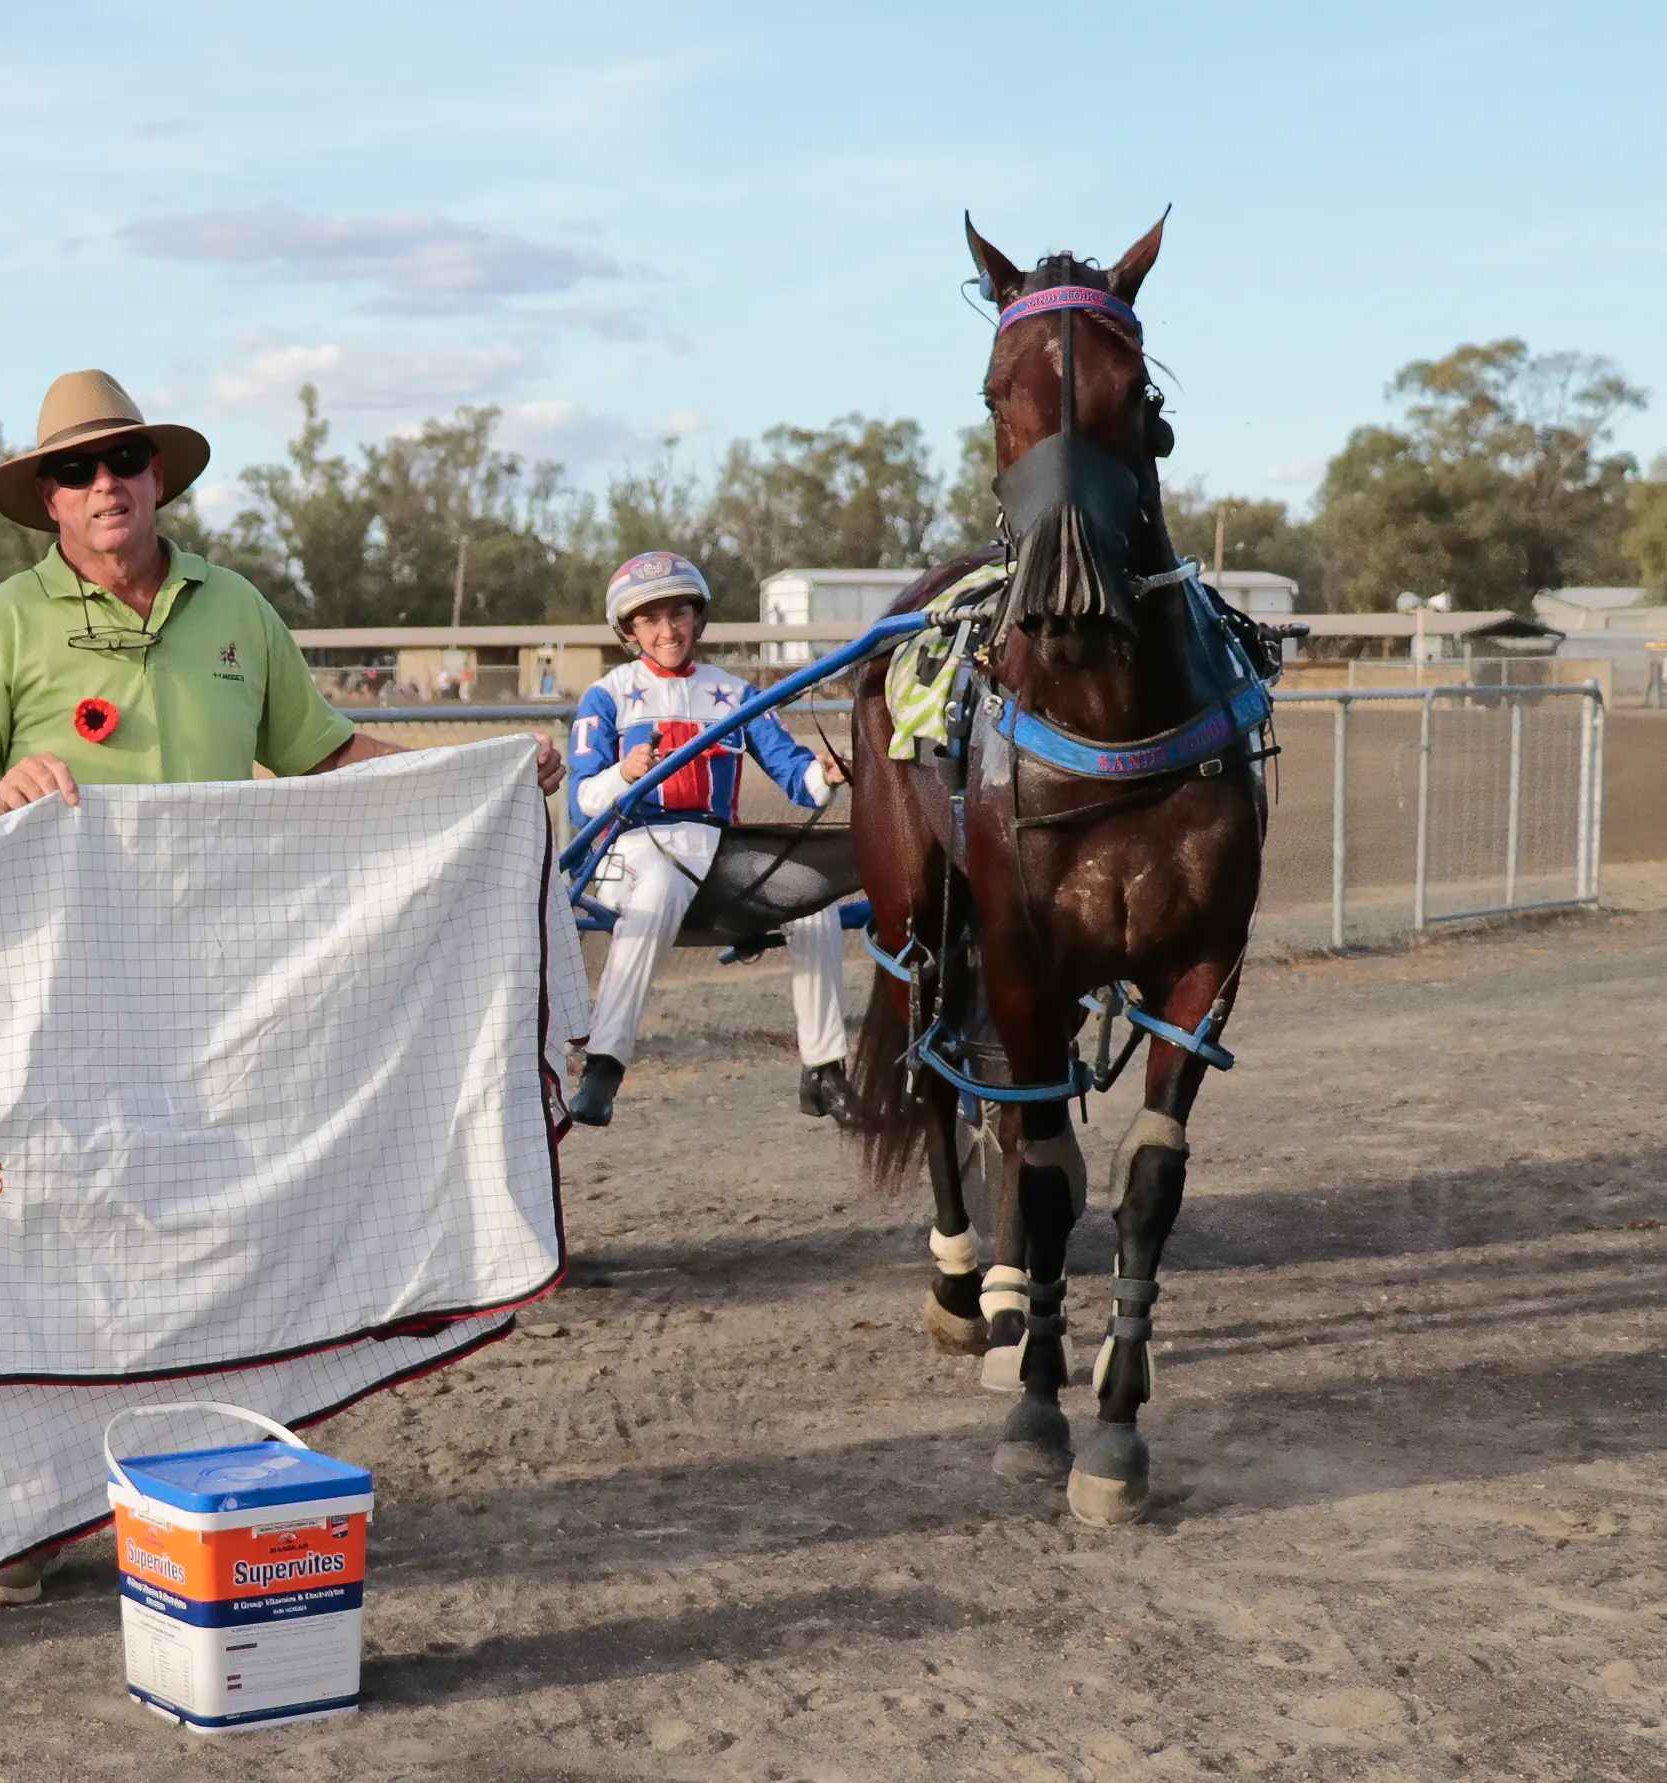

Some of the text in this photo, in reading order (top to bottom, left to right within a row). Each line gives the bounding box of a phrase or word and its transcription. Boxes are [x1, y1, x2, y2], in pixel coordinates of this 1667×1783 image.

[572, 715, 600, 756] T
[127, 1538, 185, 1584] Supervites
[234, 1550, 345, 1588] Supervites
